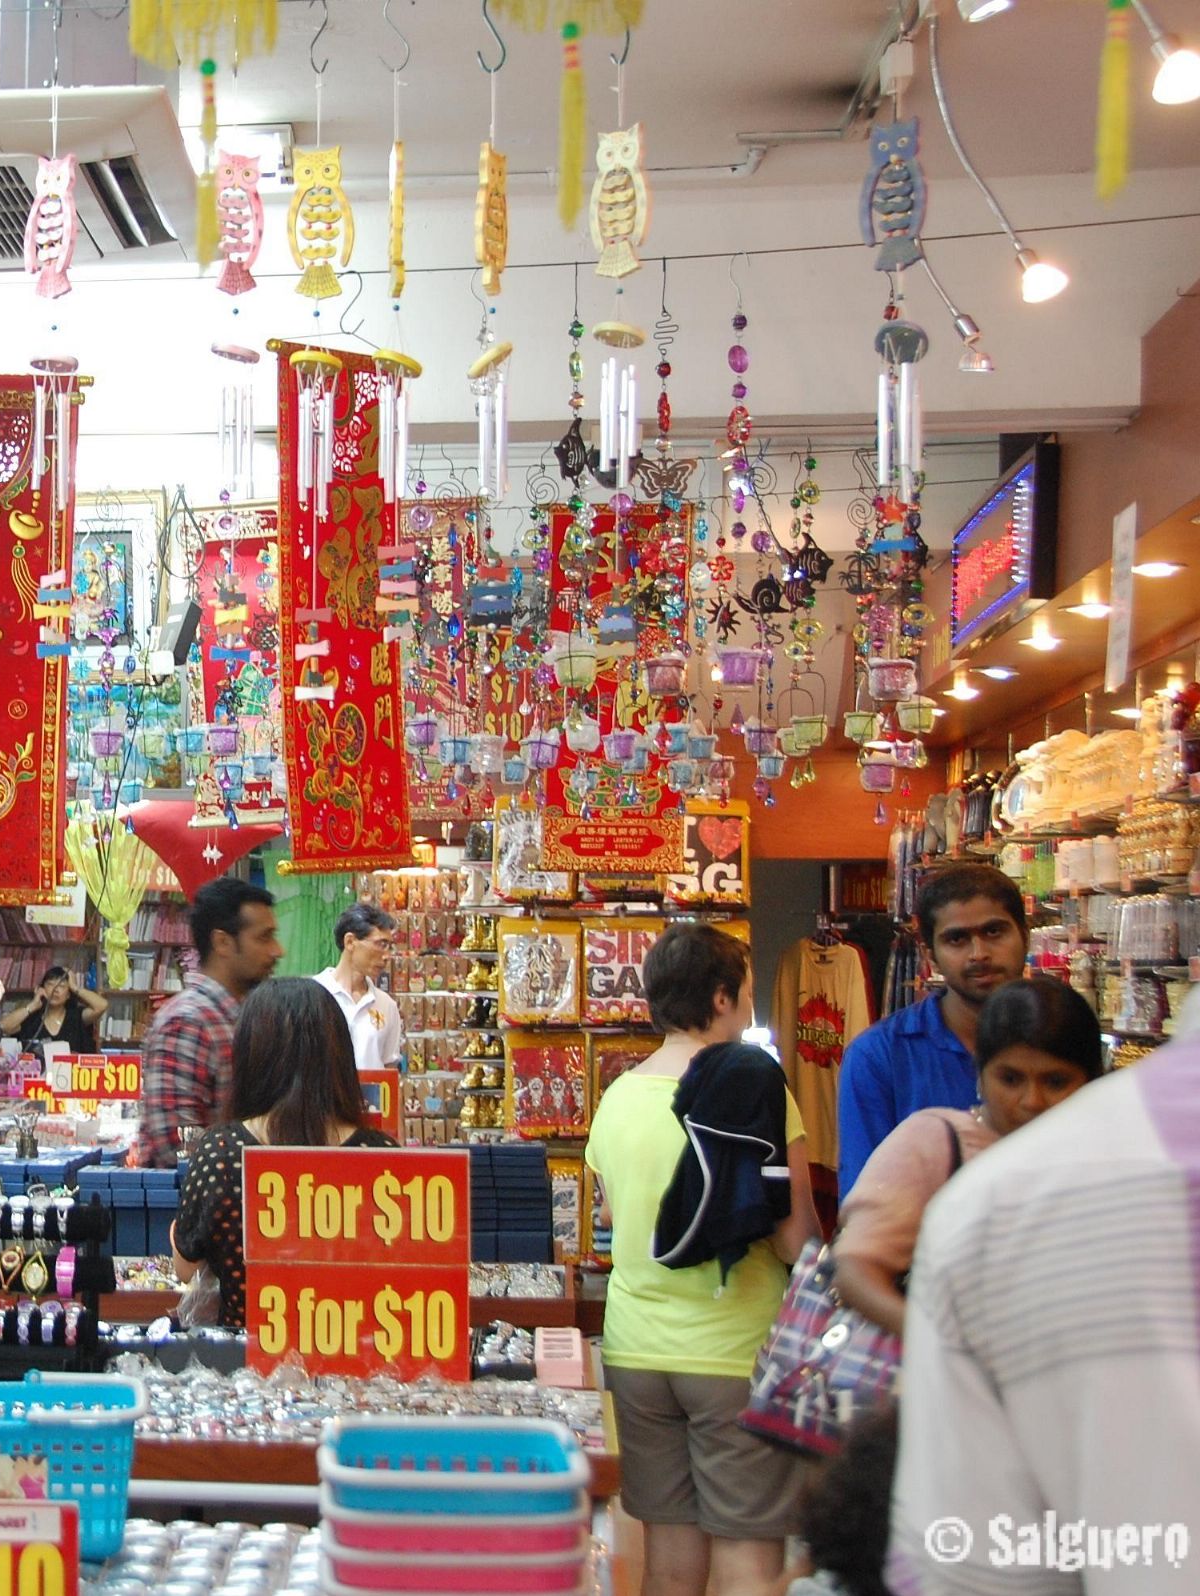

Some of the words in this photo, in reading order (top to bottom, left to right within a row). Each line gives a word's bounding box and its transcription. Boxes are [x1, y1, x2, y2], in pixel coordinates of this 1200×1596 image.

[72, 1063, 100, 1091] for
[103, 1061, 138, 1094] $10
[257, 1171, 287, 1239] 3
[296, 1173, 363, 1240] for
[372, 1169, 455, 1246] $10
[259, 1285, 288, 1355] 3
[297, 1287, 364, 1356] for
[373, 1284, 456, 1363] $10
